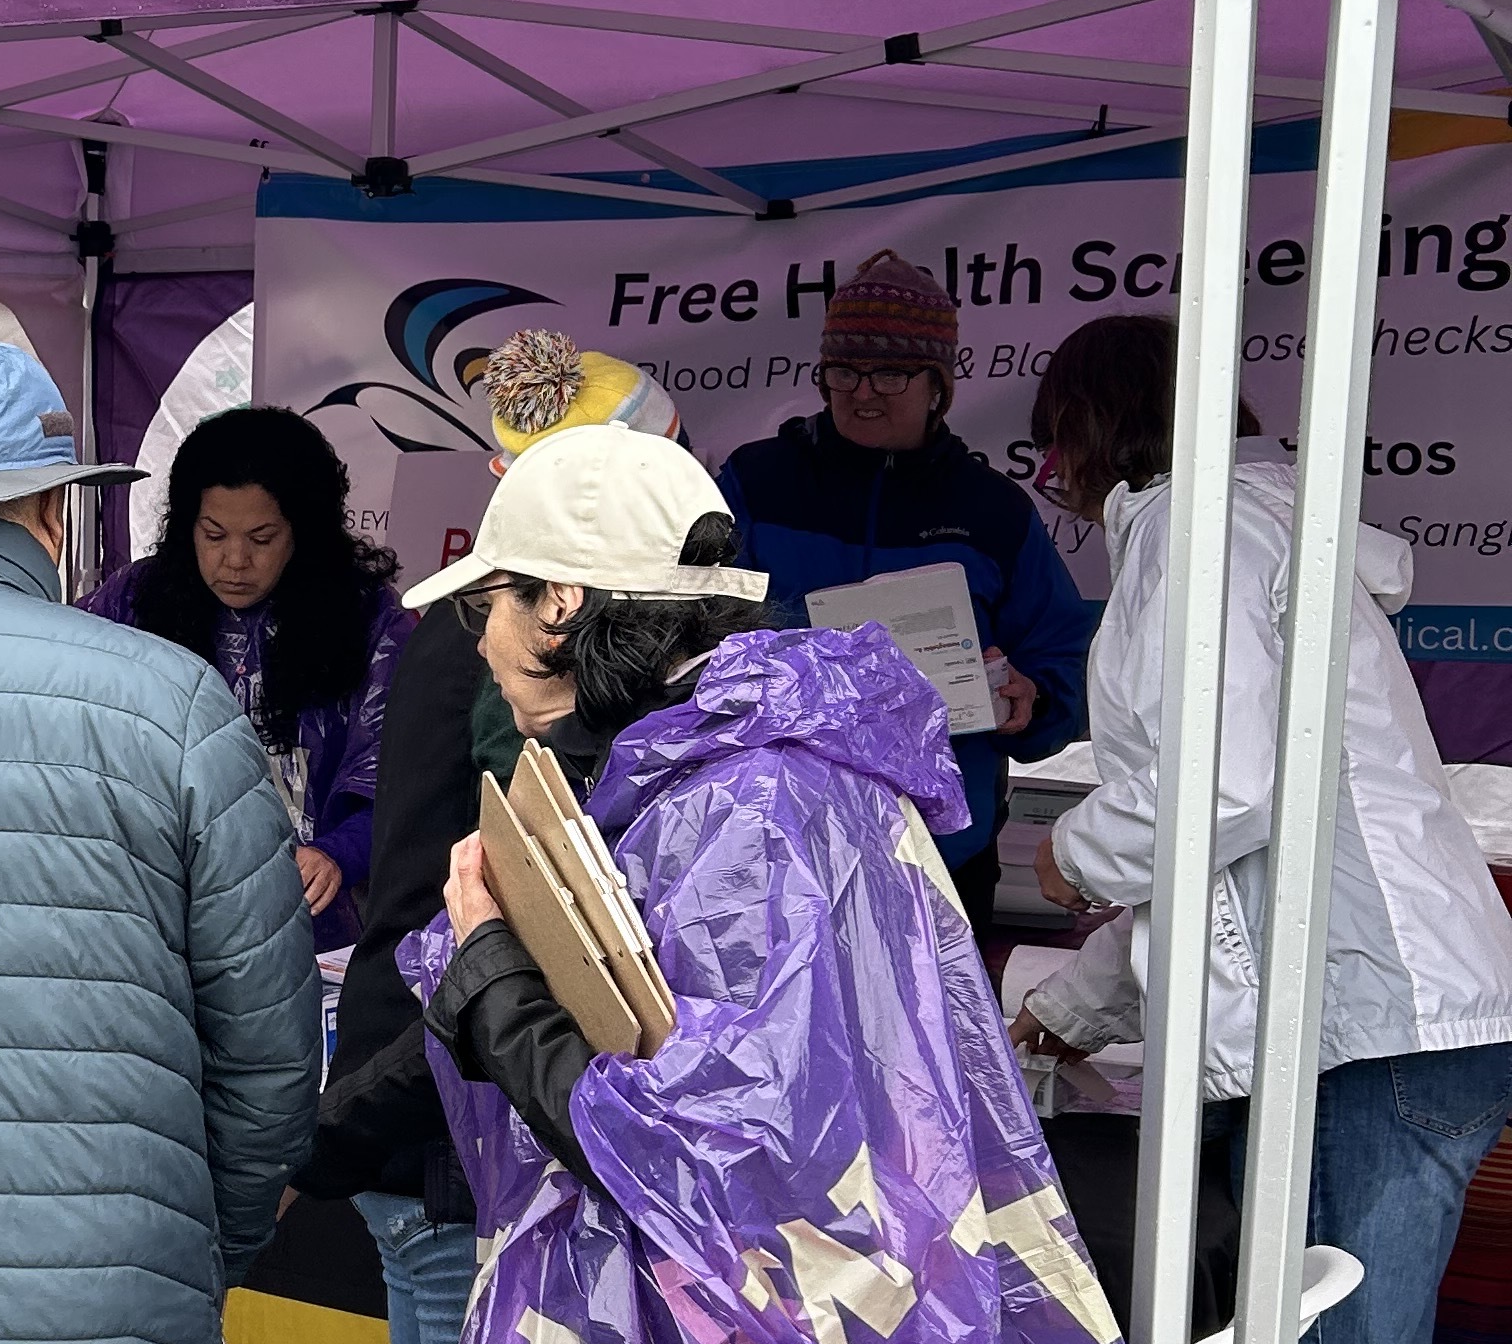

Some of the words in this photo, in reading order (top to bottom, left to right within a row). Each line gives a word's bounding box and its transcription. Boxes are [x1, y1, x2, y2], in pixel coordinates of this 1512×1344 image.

[609, 272, 759, 327] Free
[786, 243, 1043, 319] Hlth
[1371, 314, 1512, 357] hecks
